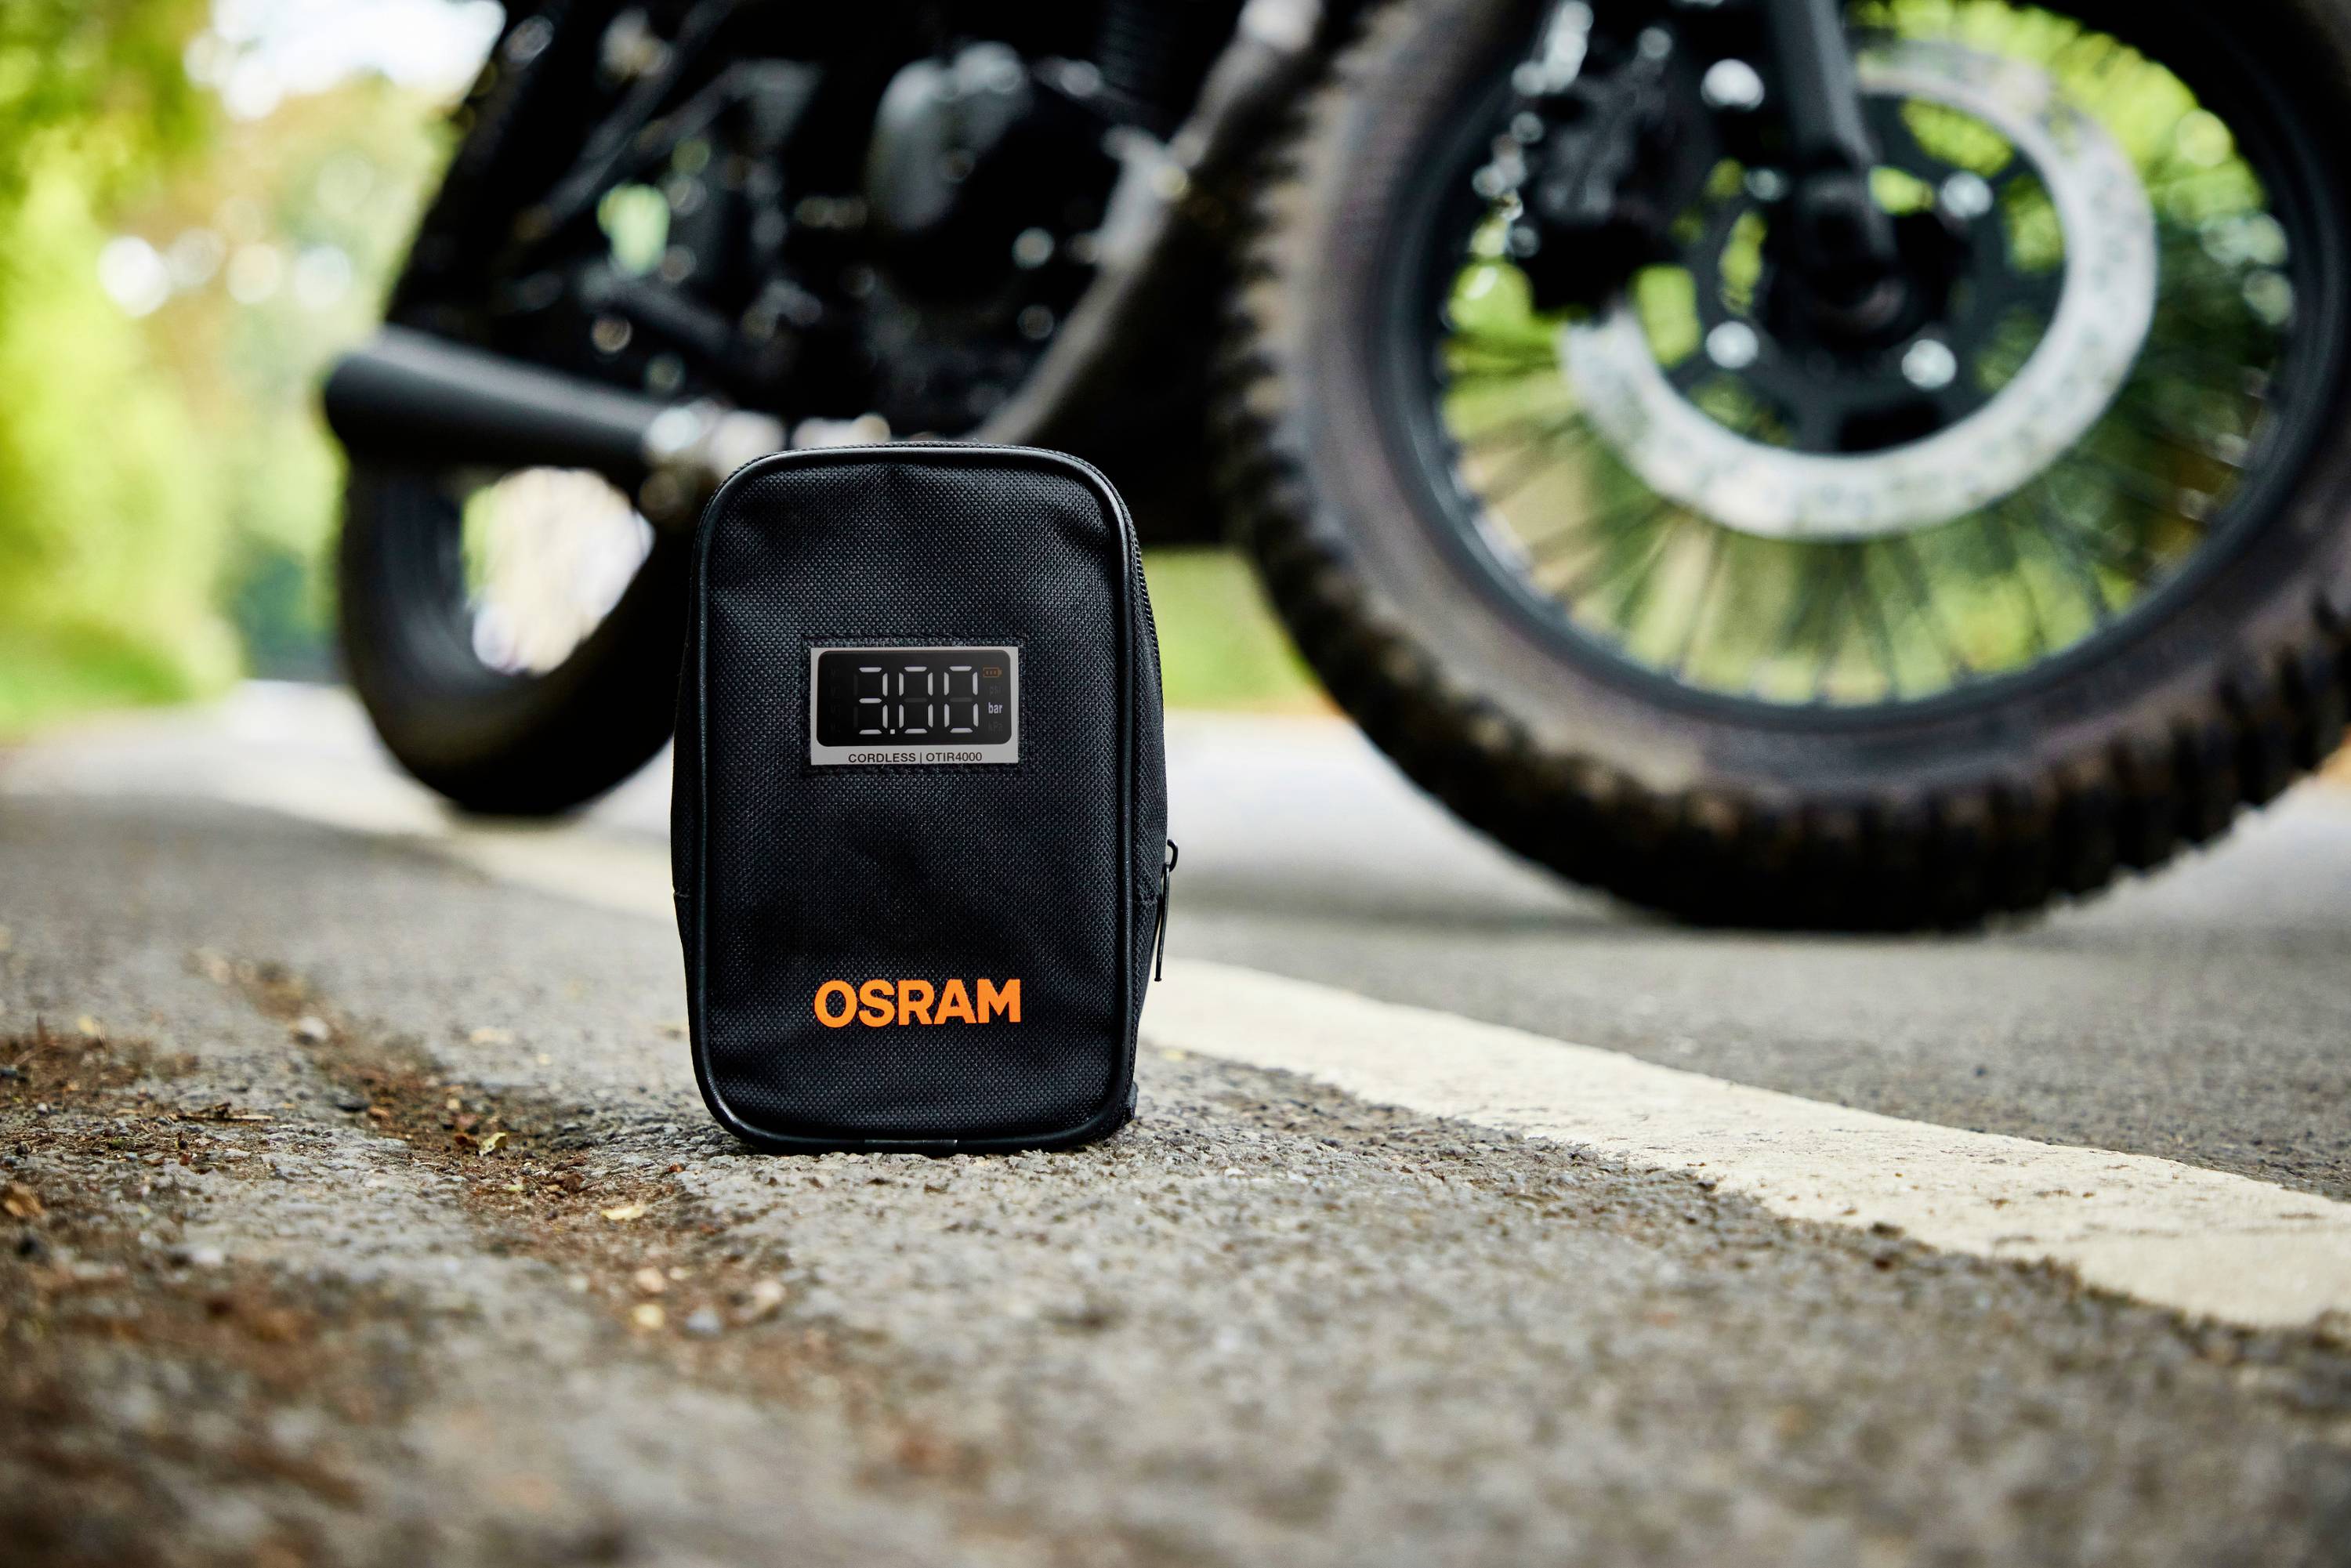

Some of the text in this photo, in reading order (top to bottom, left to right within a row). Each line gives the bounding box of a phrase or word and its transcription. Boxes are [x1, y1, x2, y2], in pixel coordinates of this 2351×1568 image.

[859, 666, 979, 735] 3.00
[988, 702, 1003, 714] bar
[848, 751, 983, 763] CORDLESS OTIR4000
[813, 978, 1021, 1028] OSRAM
